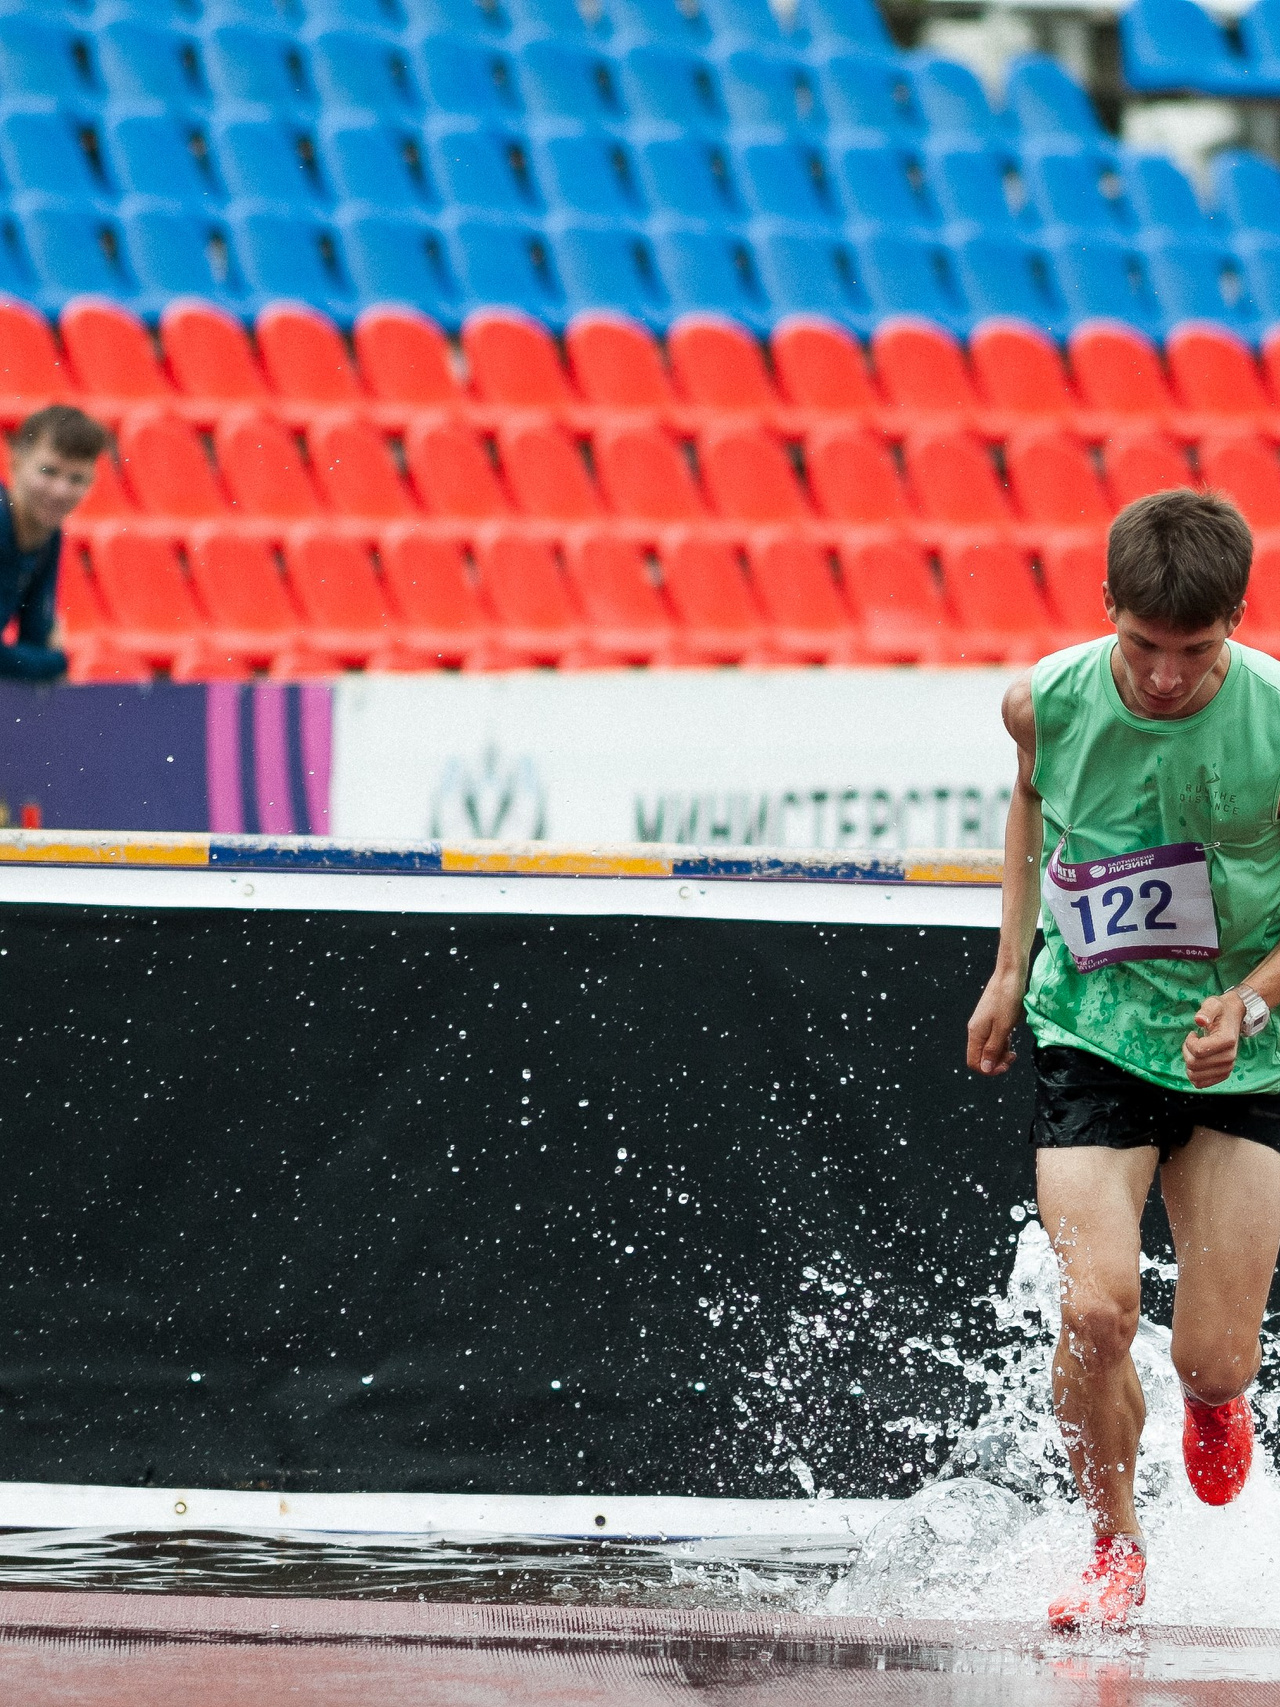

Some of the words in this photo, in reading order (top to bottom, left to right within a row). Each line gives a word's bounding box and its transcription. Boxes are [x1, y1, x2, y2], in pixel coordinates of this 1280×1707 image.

[1213, 791, 1237, 803] THE
[1108, 858, 1155, 874] ЛИЗИНГ
[1070, 879, 1177, 945] 122
